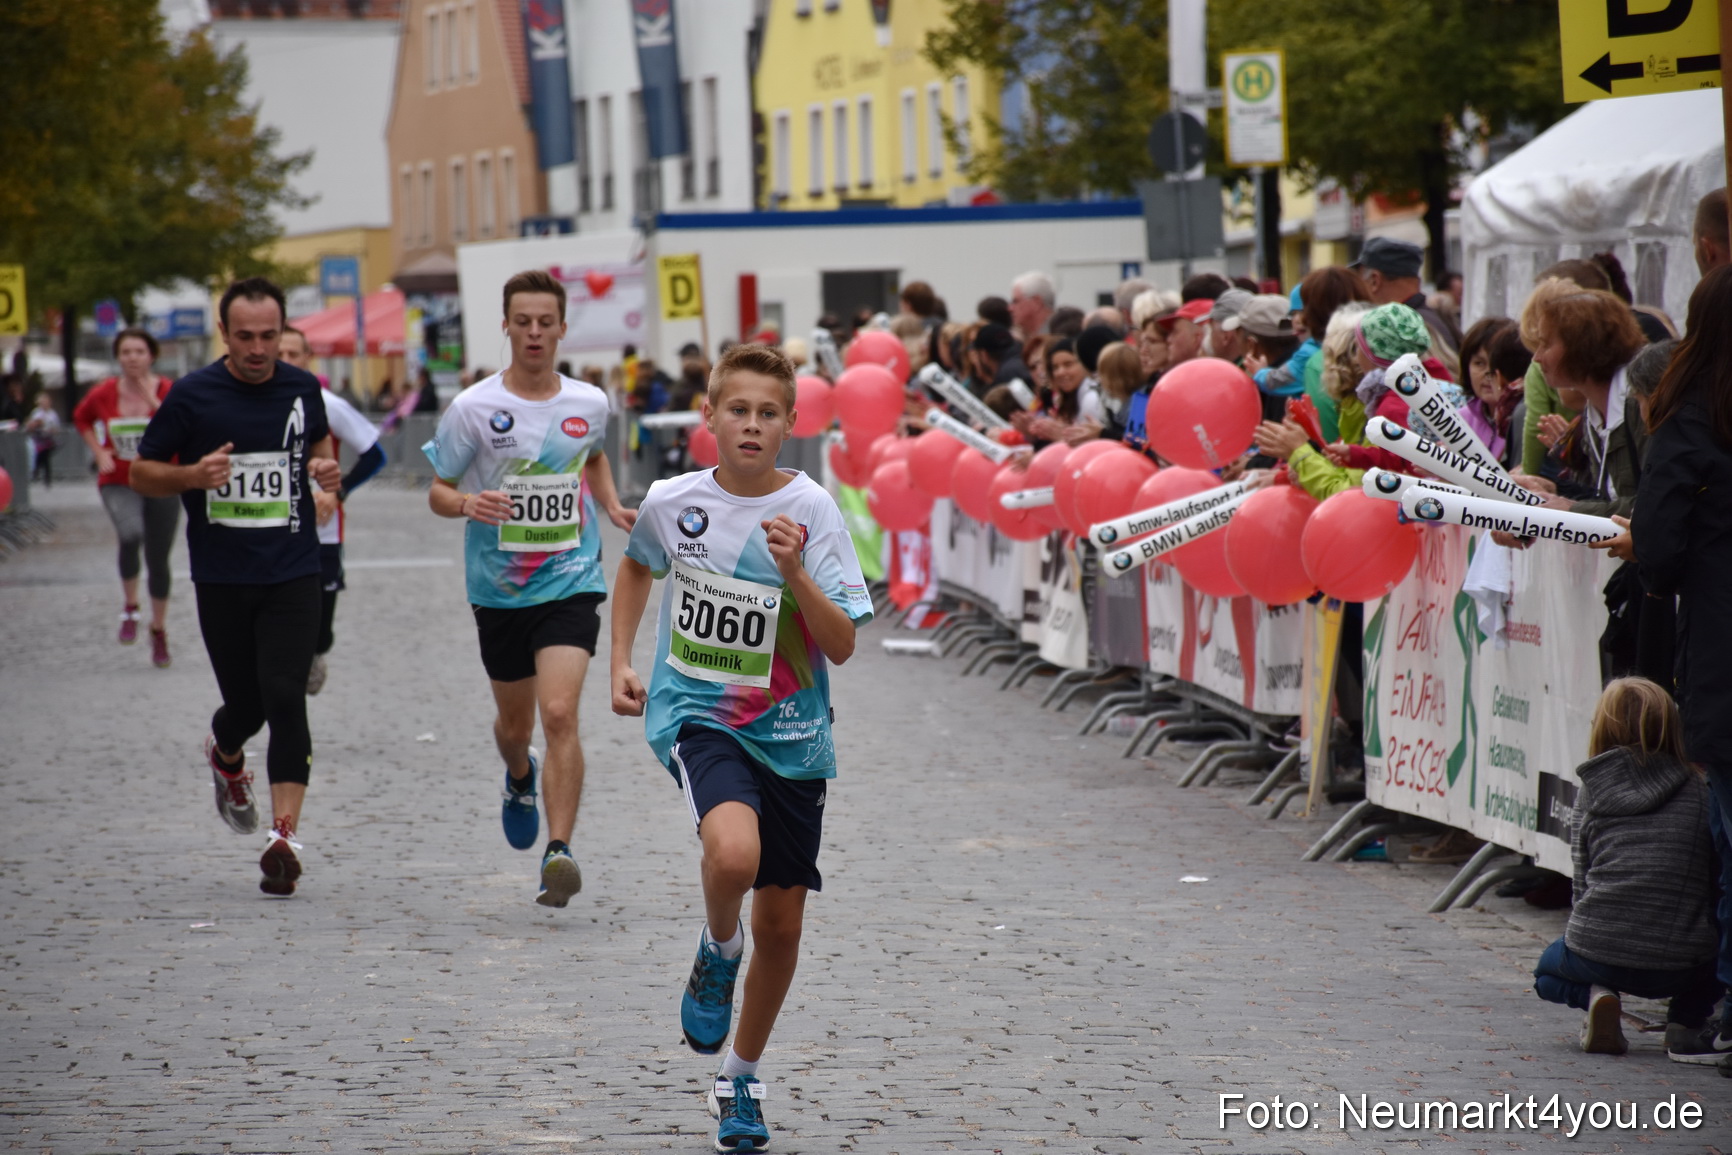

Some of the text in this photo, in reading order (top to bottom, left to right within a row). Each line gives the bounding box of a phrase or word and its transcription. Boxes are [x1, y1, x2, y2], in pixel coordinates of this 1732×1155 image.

[670, 273, 693, 306] D
[1419, 397, 1466, 445] BMW
[491, 436, 518, 446] PARTL
[502, 482, 569, 492] PARTL Neumarkt
[509, 493, 574, 522] 5089
[525, 530, 560, 541] Dustin
[677, 542, 708, 552] PARTL
[1140, 528, 1183, 559] BMW
[677, 551, 708, 559] Neumarkt
[675, 571, 758, 605] PARTL Neumarkt
[678, 590, 766, 648] 5060
[683, 643, 742, 671] Dominik
[778, 701, 799, 718] 16.
